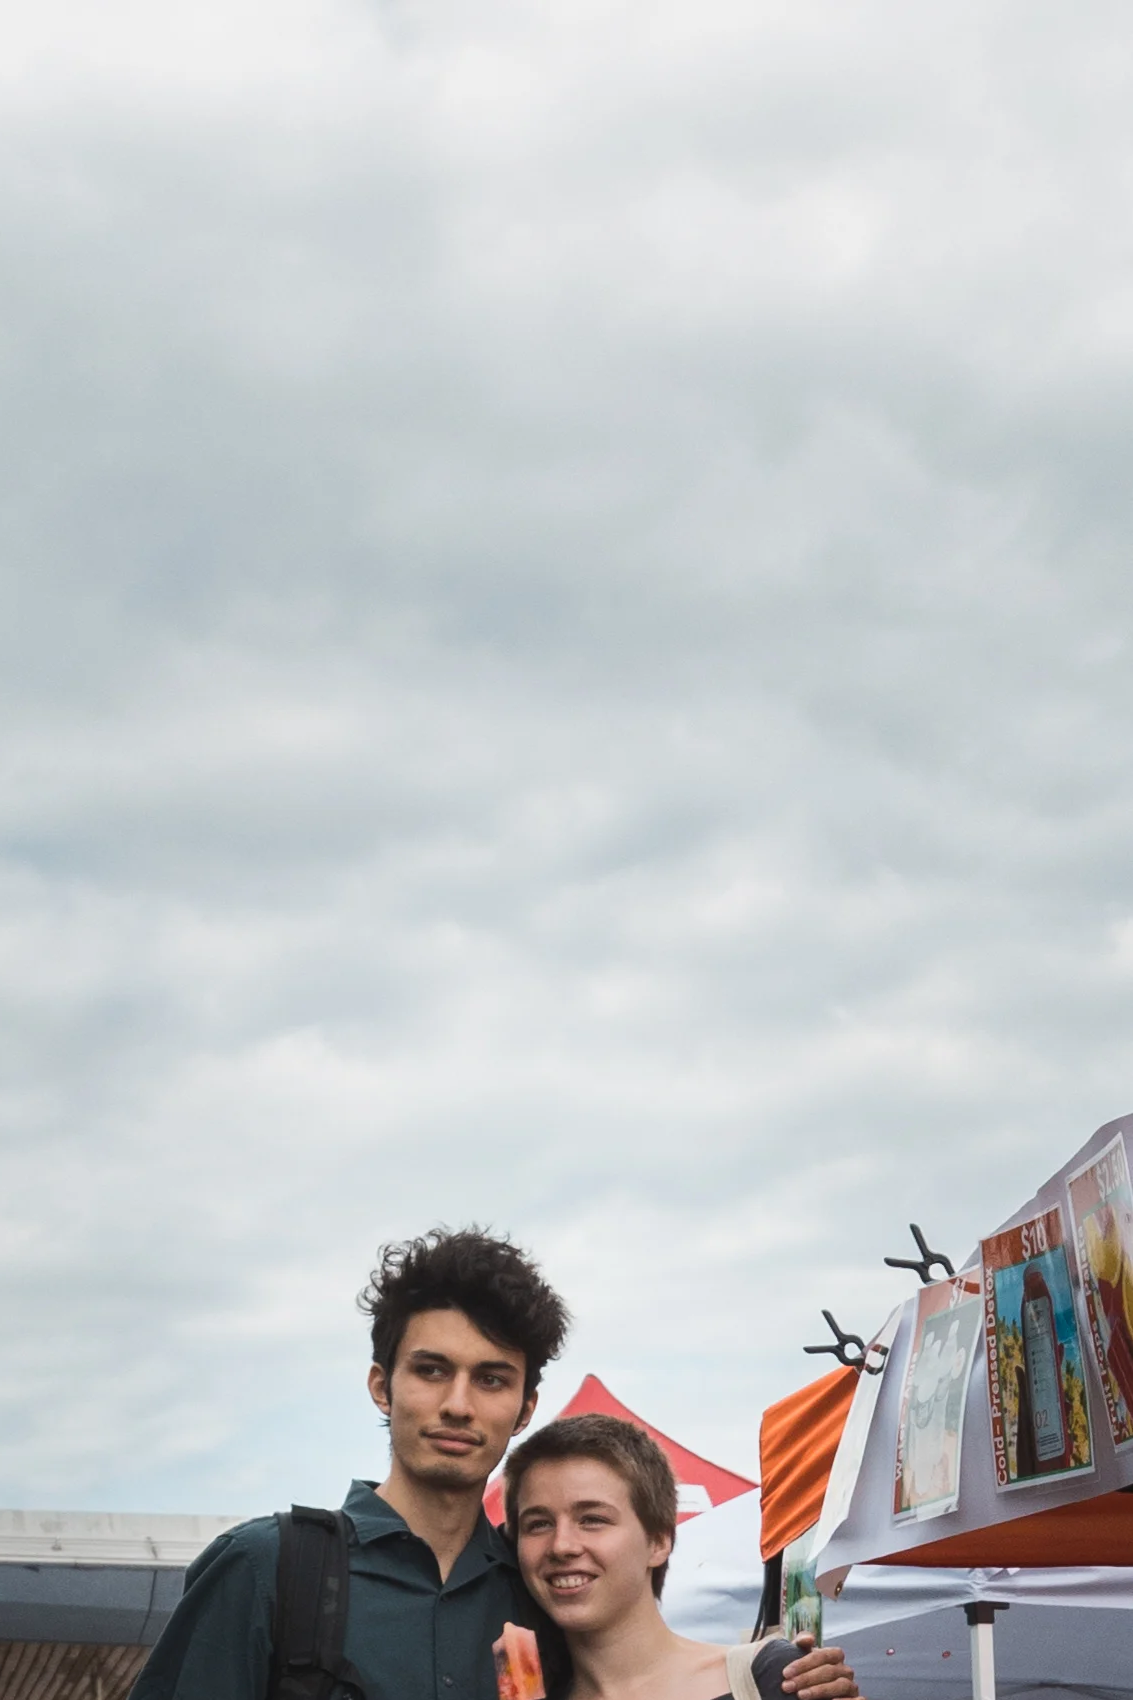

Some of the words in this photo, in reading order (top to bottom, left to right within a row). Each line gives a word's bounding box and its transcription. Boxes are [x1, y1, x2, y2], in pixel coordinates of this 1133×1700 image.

[1021, 1220, 1048, 1262] $10
[949, 1277, 966, 1311] $7
[985, 1265, 996, 1329] Detox
[986, 1334, 1002, 1418] Pressed
[1093, 1321, 1107, 1376] Pops
[1104, 1382, 1120, 1436] Fruit
[895, 1422, 907, 1480] Water
[993, 1424, 1008, 1486] Cold-
